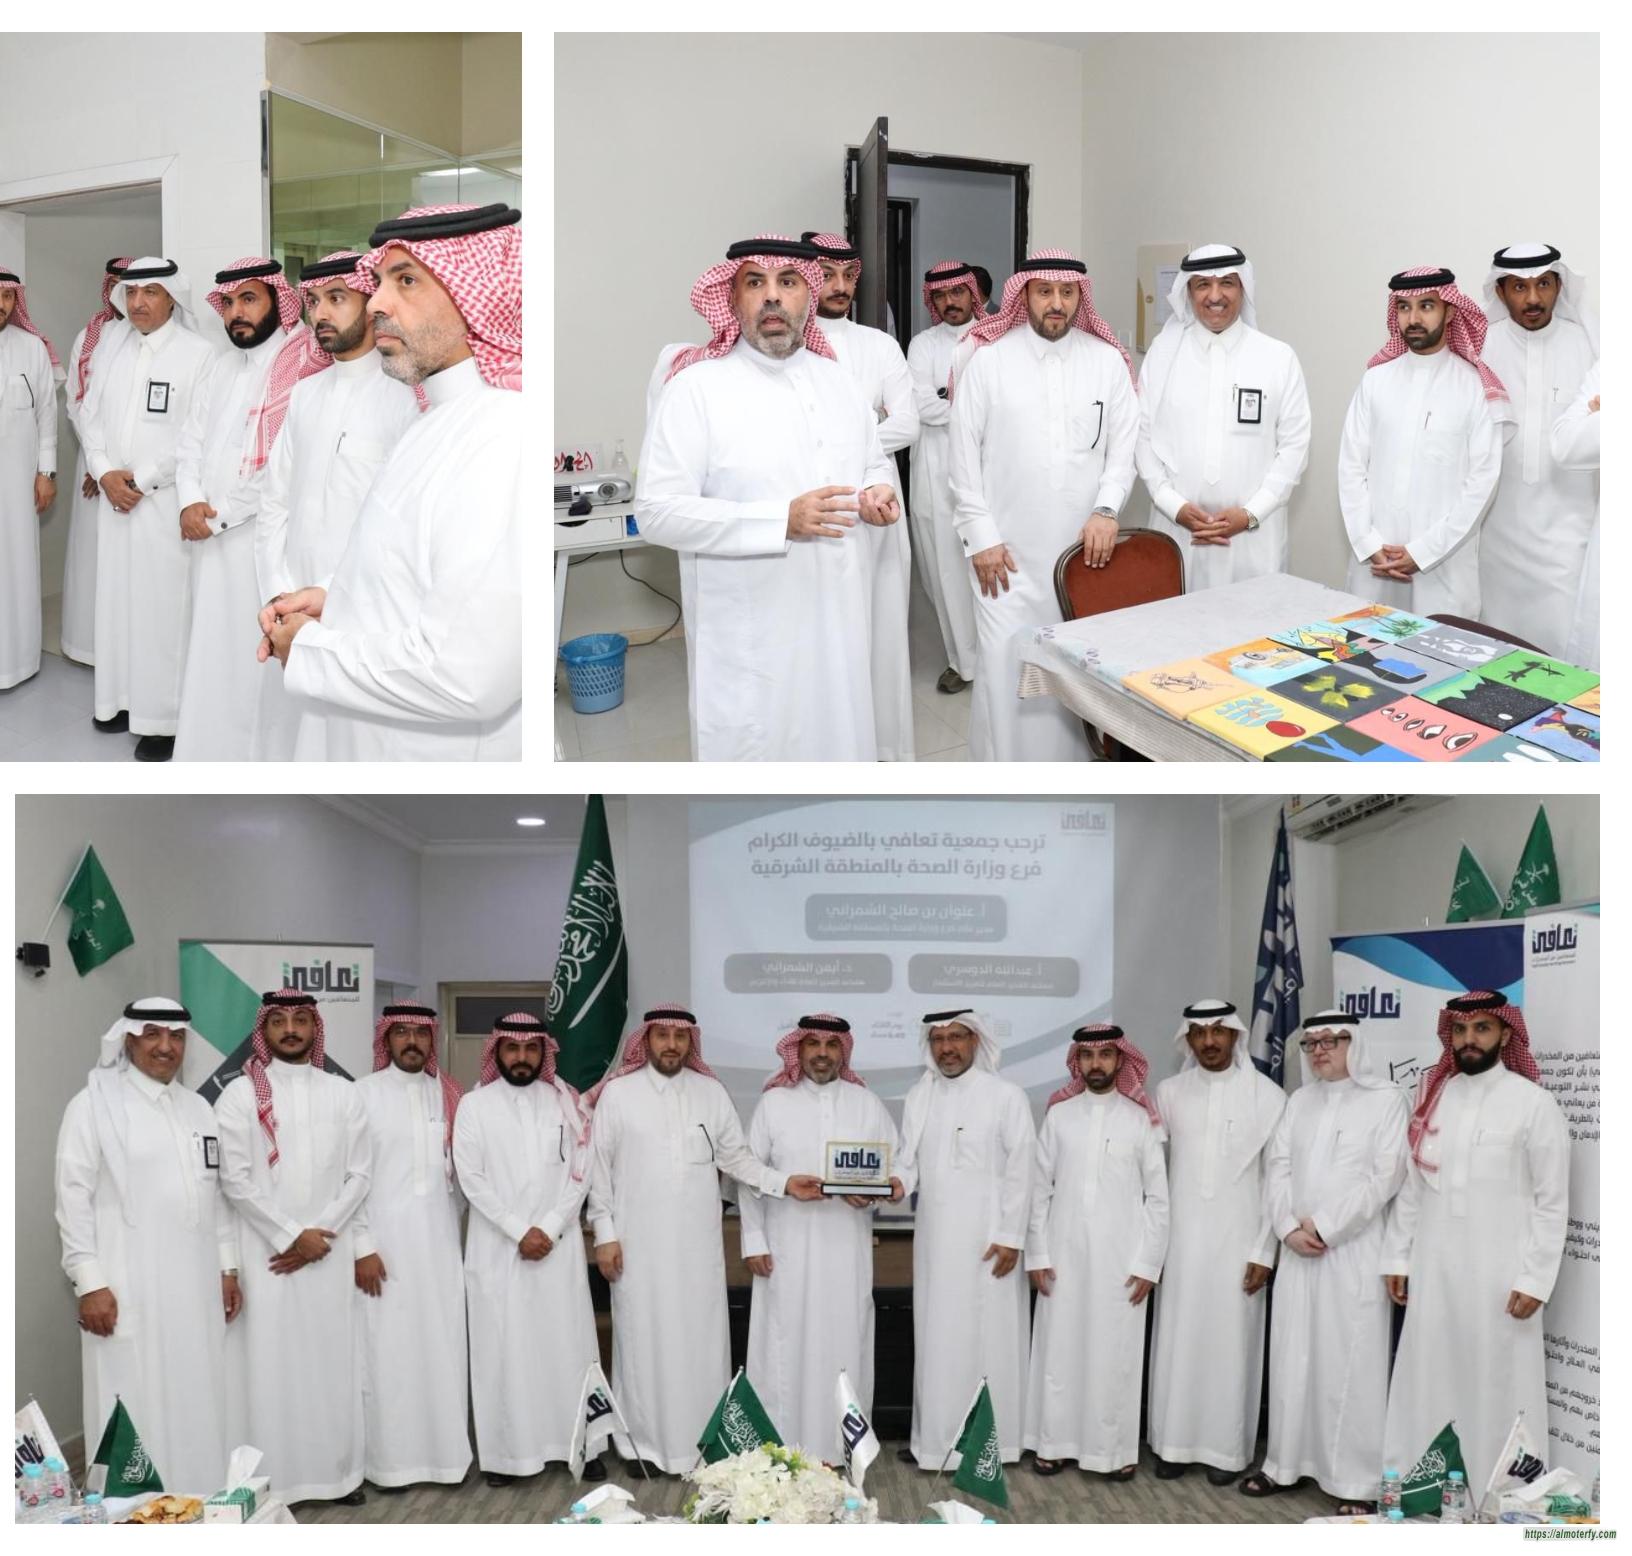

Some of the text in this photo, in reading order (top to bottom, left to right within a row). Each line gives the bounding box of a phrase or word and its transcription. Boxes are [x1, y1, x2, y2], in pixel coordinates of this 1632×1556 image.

[748, 831, 1047, 853] ترحب جمعية تعافي بالضيوف الكرام
[751, 857, 1042, 881] فرع وزارة الصحة بالمنطقة الشرقية
[1531, 923, 1579, 954] تعافي
[282, 959, 360, 993] تعافي
[1339, 986, 1401, 1019] تعافي
